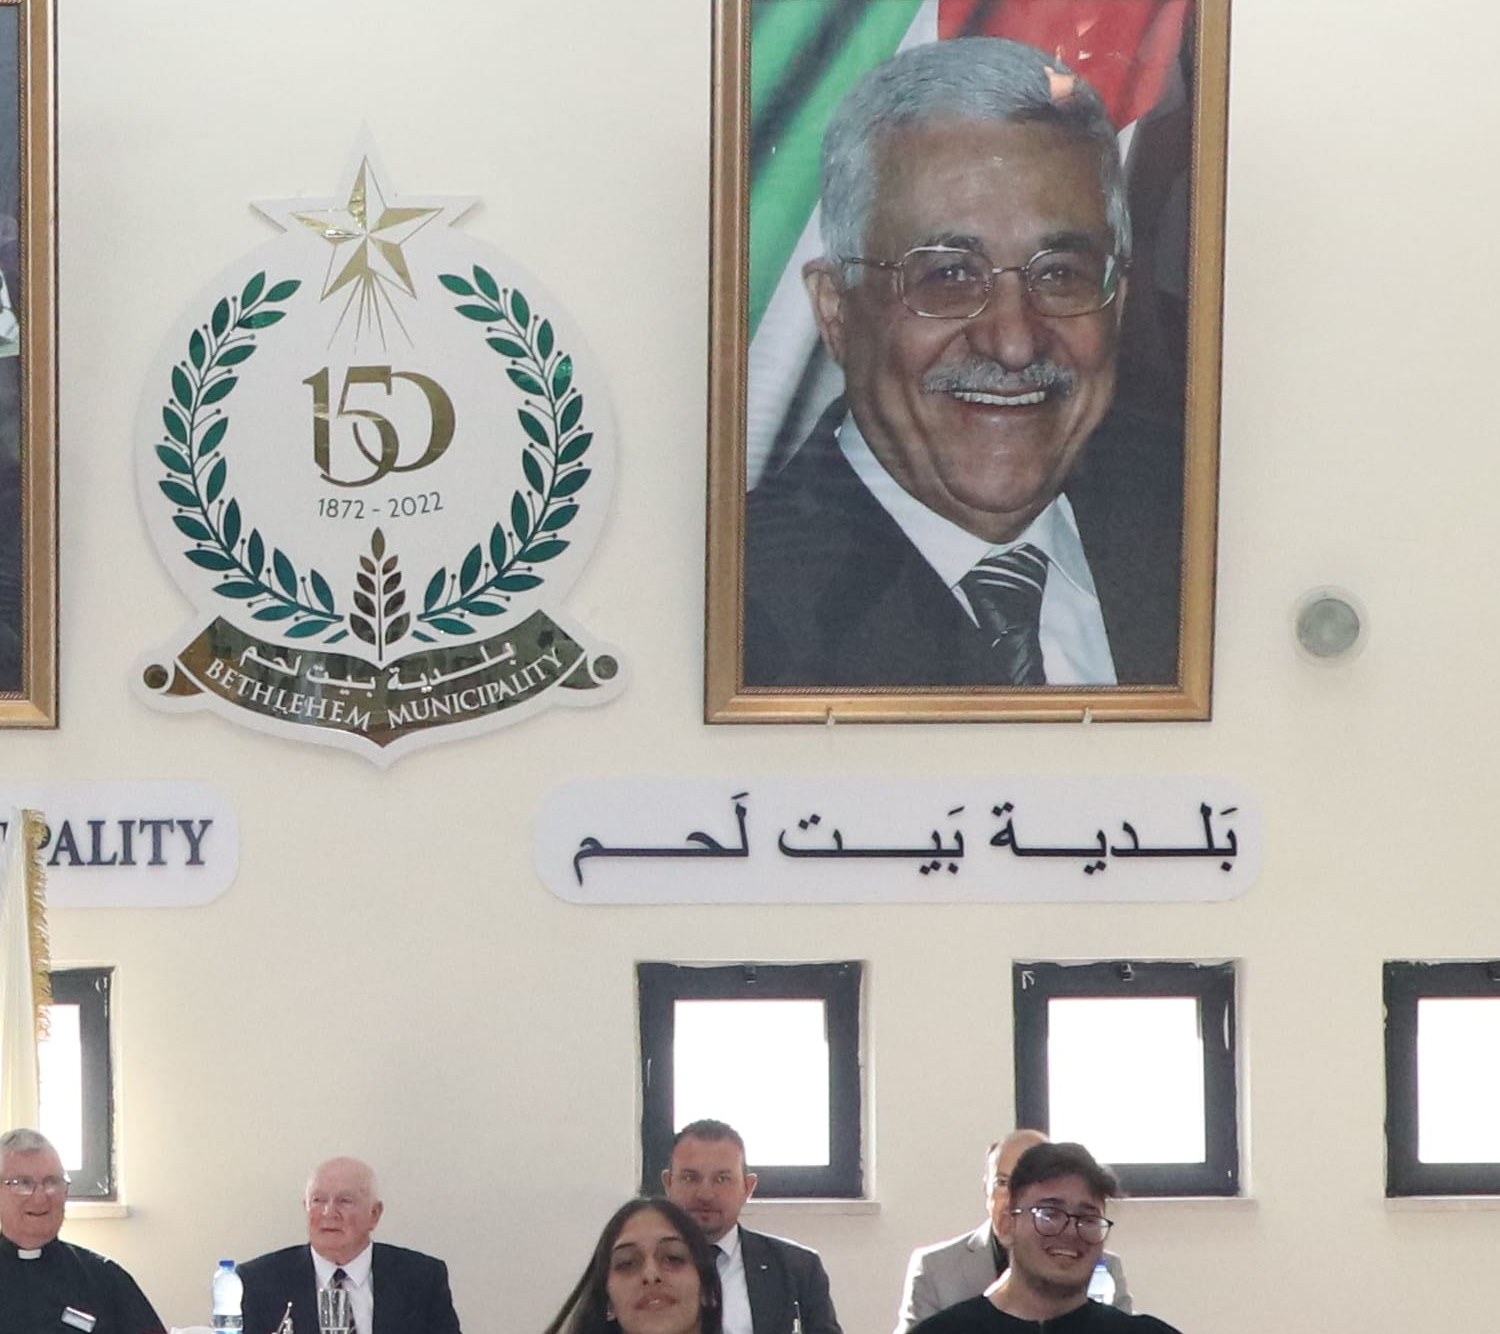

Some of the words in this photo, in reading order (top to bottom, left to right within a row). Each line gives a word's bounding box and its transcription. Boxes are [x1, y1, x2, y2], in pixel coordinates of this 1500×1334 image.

[302, 365, 456, 488] 150
[318, 498, 365, 519] 1872
[387, 491, 444, 518] 2022
[239, 646, 303, 677] لحم
[204, 657, 371, 732] BETHLEHEM
[387, 646, 573, 730] MUNICIPALITY
[306, 665, 377, 698] بيت
